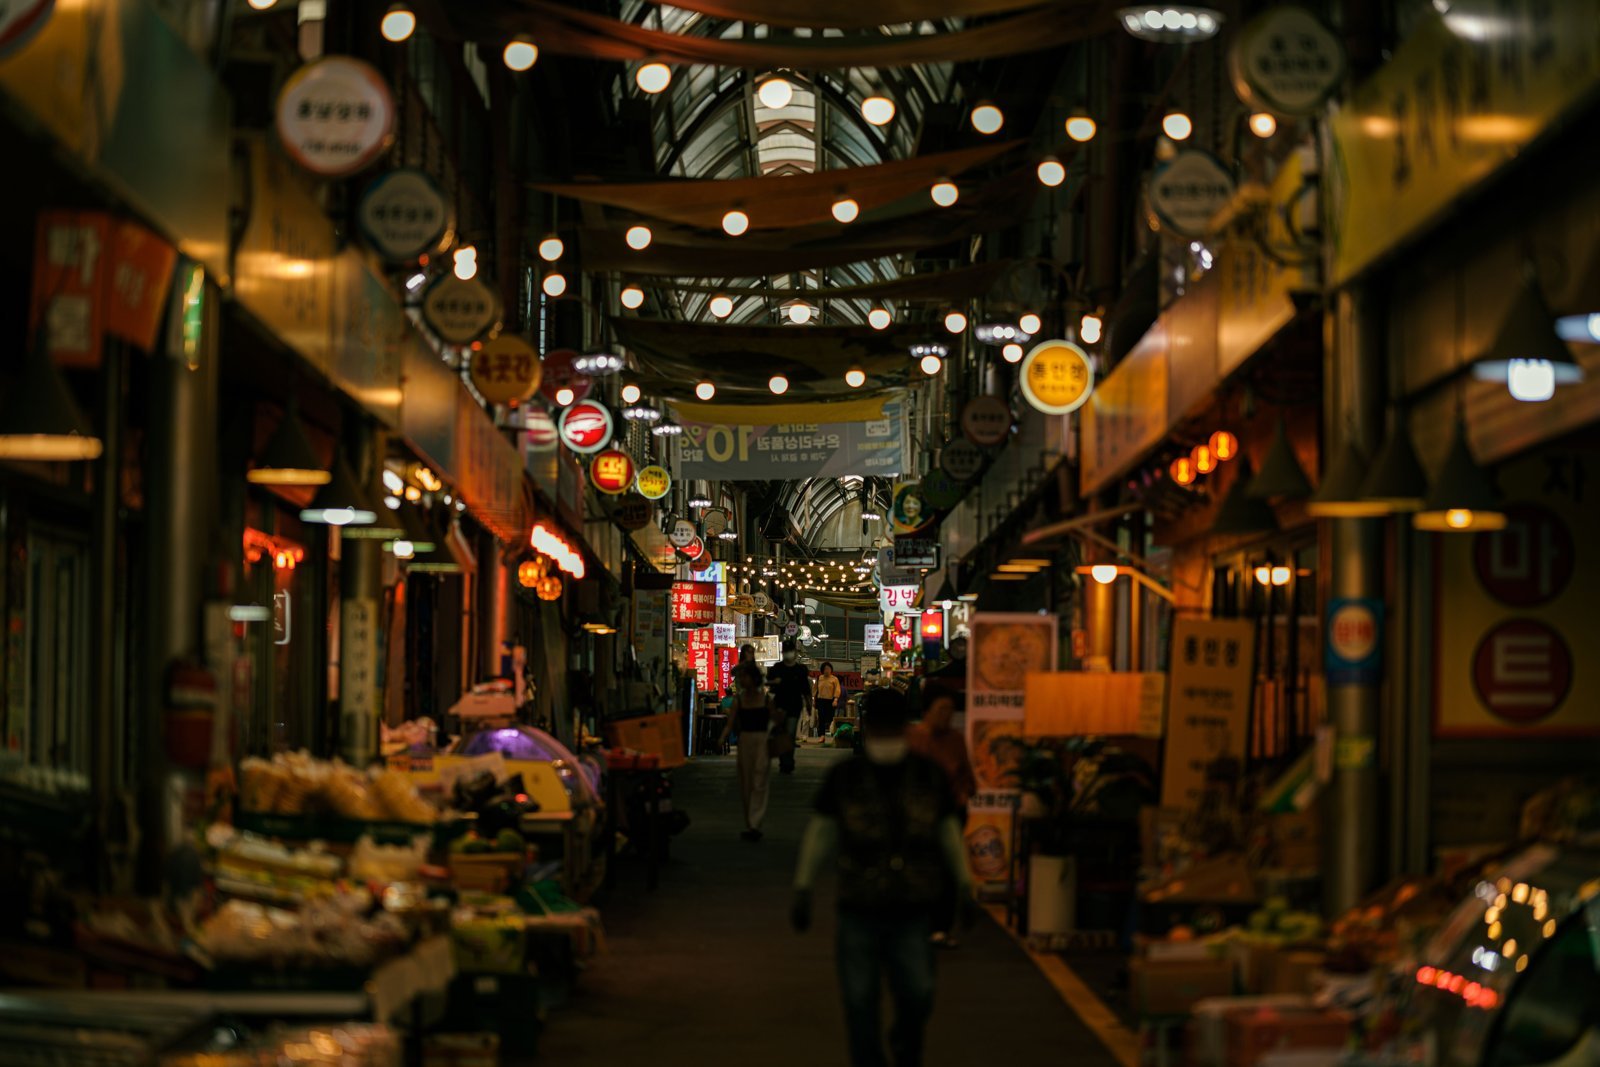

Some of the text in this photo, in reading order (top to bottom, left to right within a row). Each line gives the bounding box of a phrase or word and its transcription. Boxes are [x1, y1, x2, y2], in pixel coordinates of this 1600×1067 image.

[598, 455, 628, 487] 떡
[883, 588, 917, 608] 김밥
[1487, 519, 1560, 709] 마트
[691, 641, 711, 650] 할머니
[895, 615, 911, 650] 김밥
